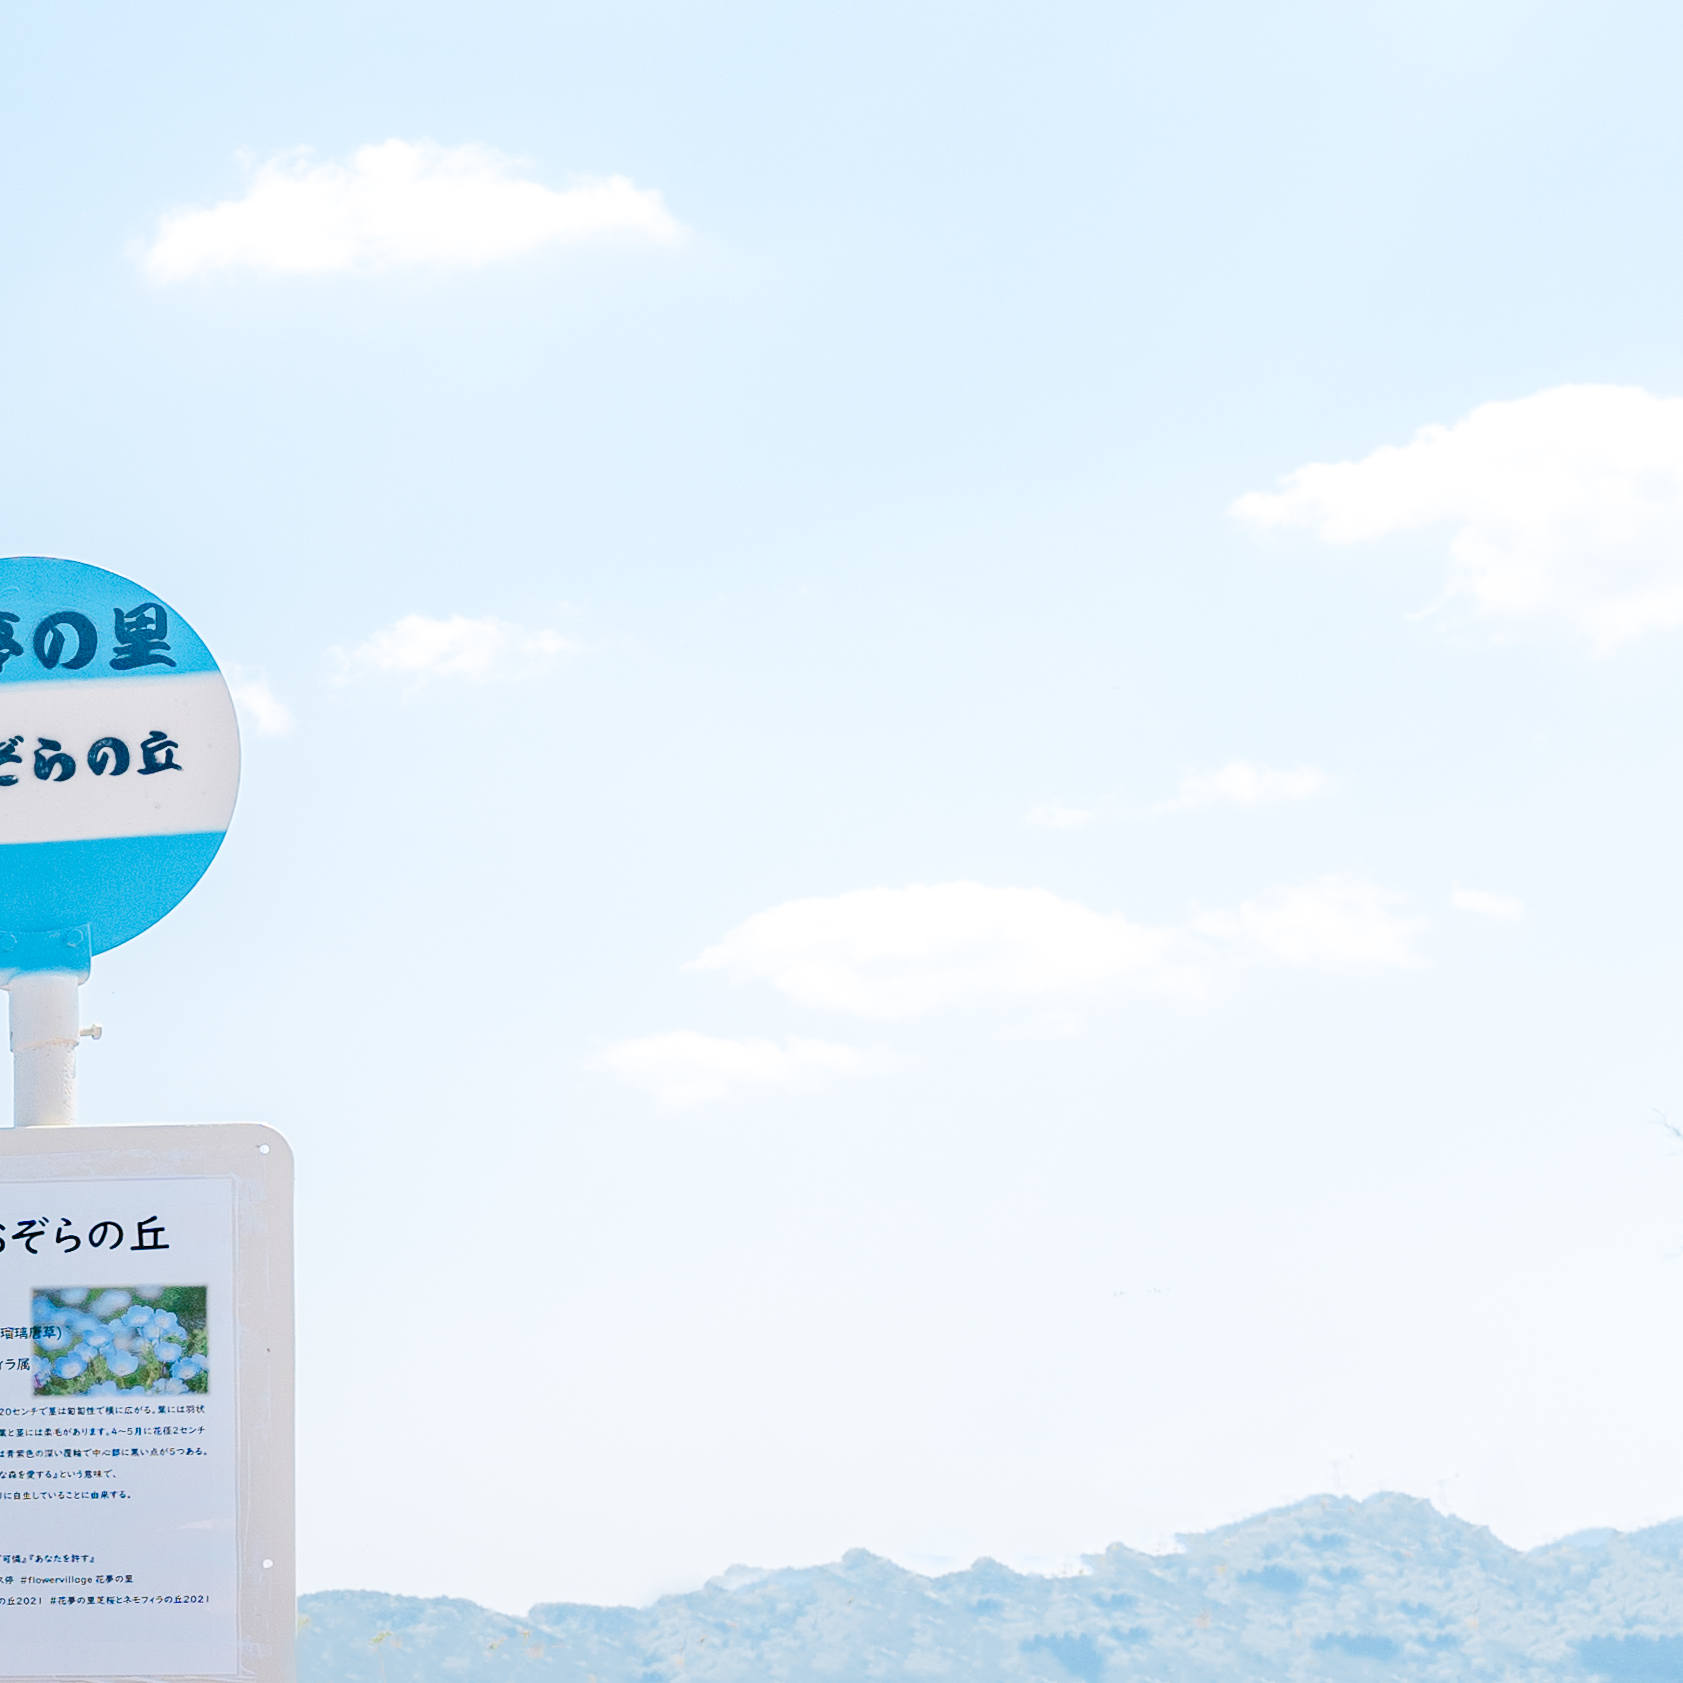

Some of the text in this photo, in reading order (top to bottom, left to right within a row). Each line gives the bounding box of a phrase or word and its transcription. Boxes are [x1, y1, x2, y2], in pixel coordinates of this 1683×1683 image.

[19, 1575, 93, 1586] #flowervillage
[95, 1574, 134, 1585] 花夢の里
